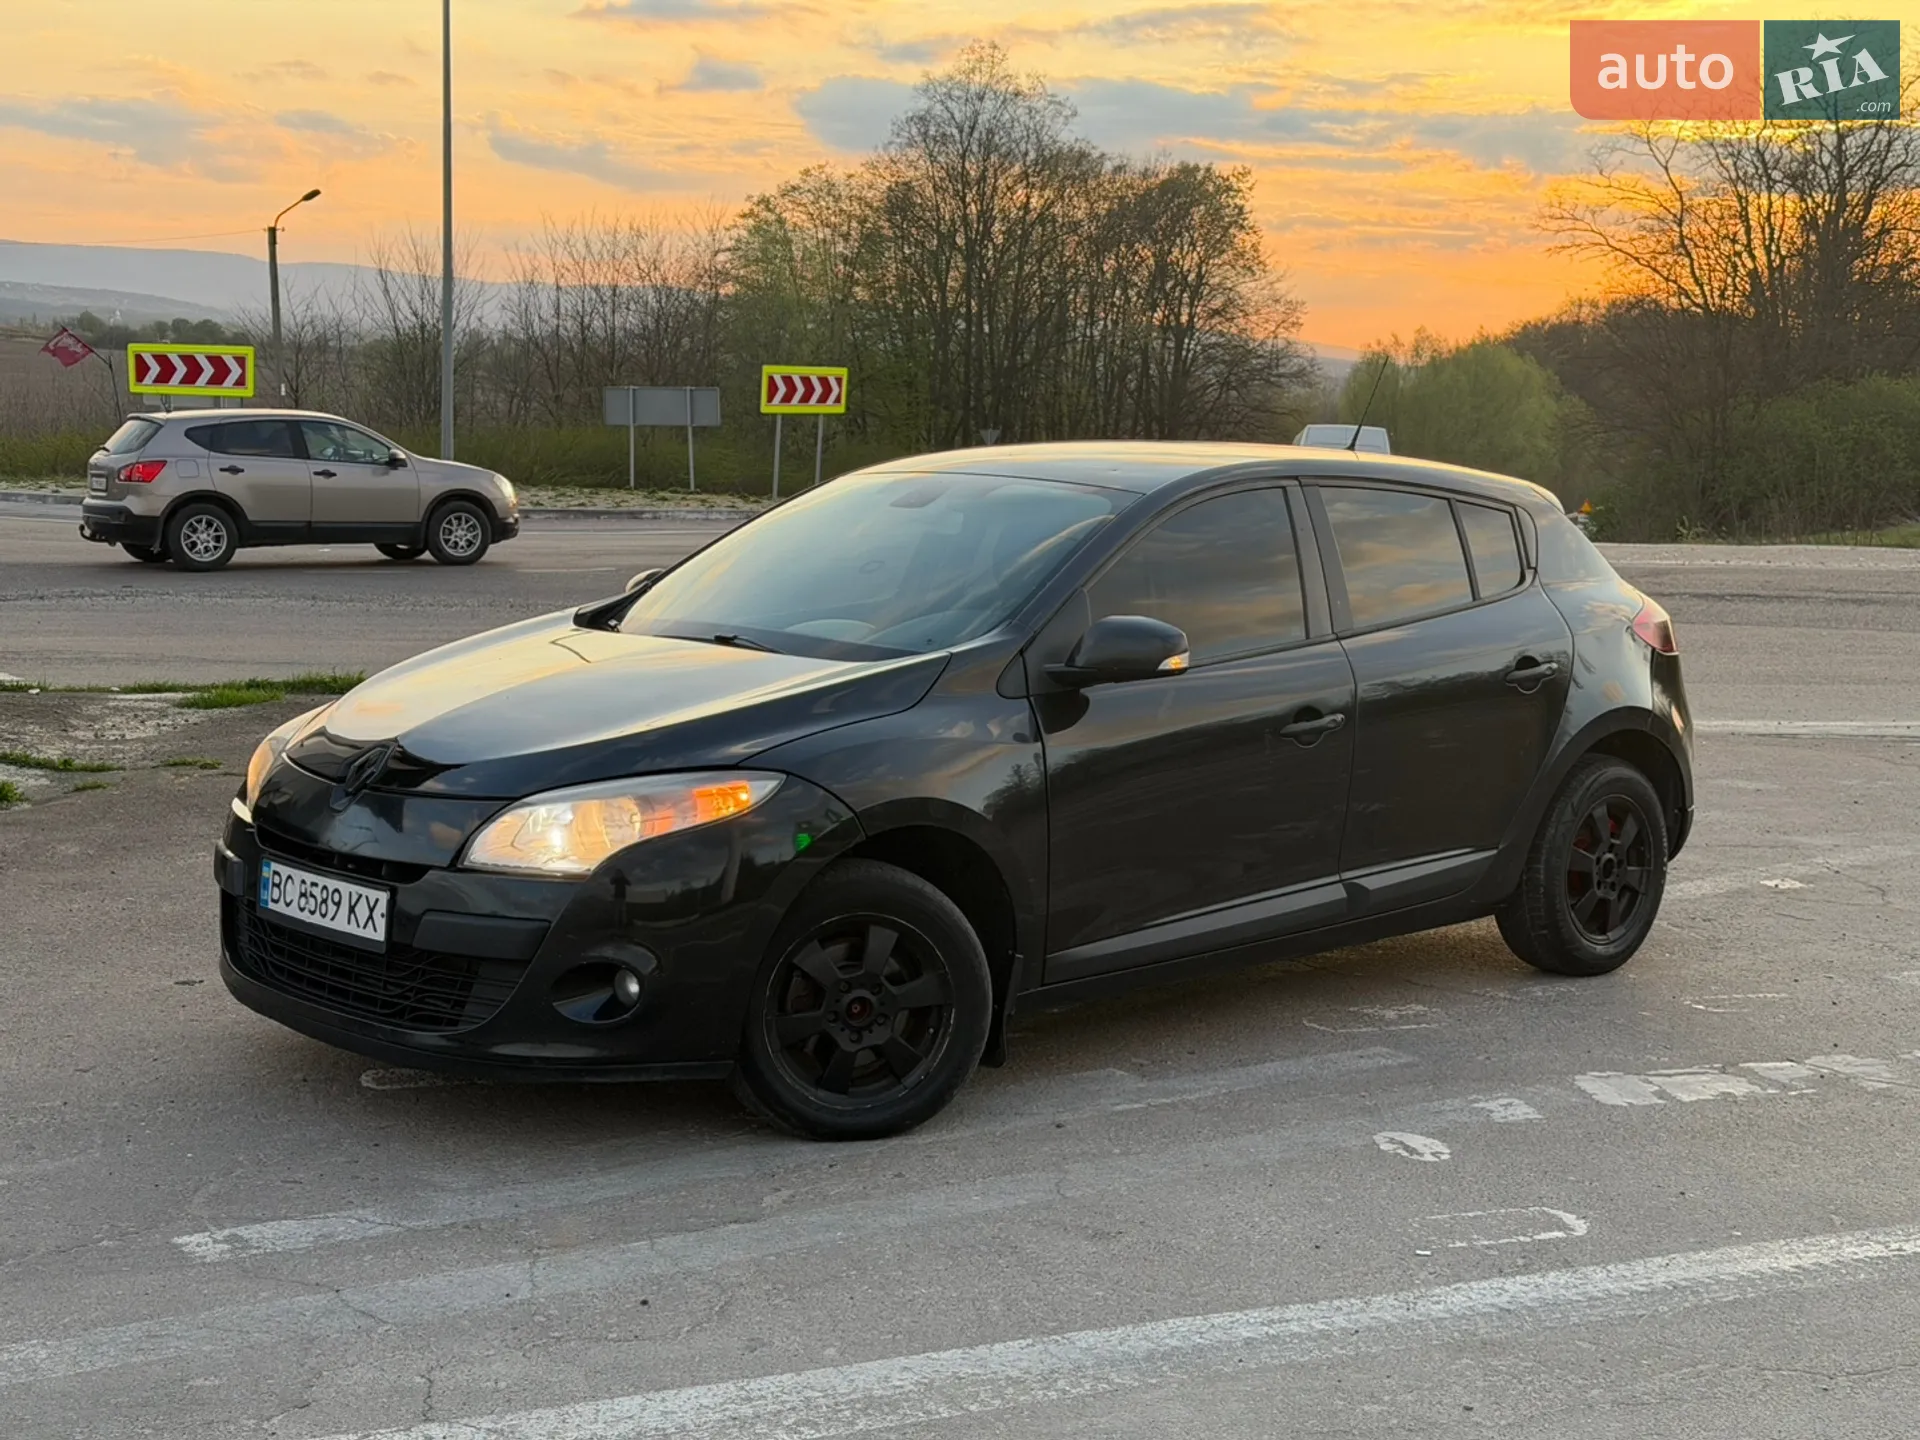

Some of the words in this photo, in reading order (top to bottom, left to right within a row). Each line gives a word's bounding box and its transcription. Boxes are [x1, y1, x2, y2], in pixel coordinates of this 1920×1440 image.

[270, 869, 295, 908] BC
[297, 878, 343, 922] 8589
[347, 890, 380, 934] KX
